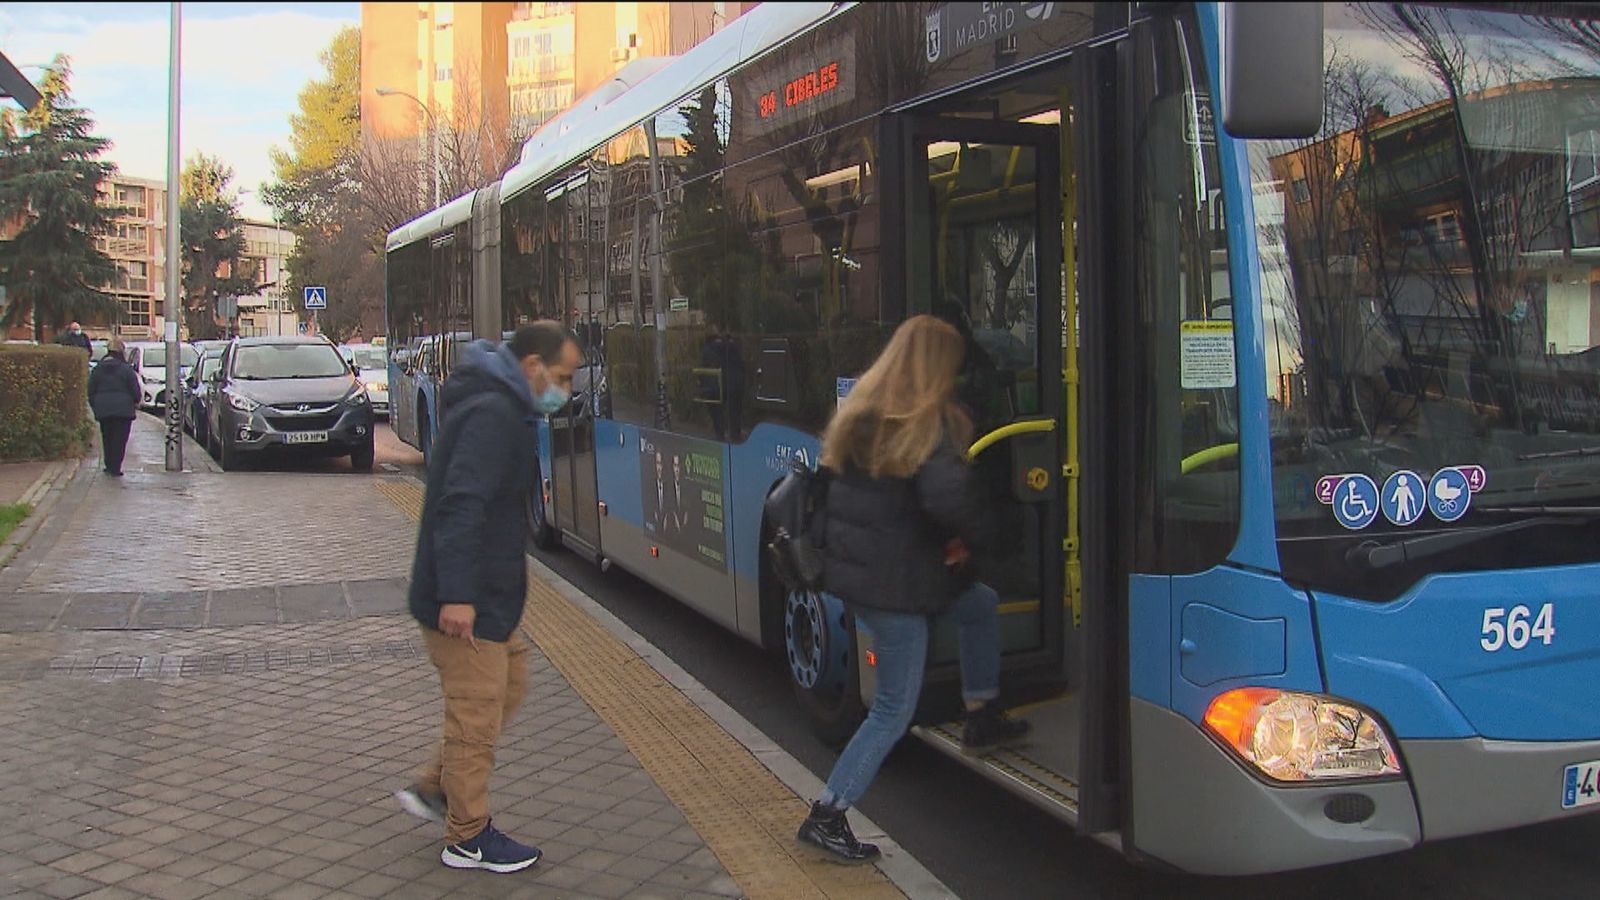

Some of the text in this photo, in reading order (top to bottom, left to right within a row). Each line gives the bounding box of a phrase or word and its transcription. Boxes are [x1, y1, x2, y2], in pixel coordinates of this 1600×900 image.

[956, 8, 1015, 48] MADRID
[760, 90, 777, 118] 84
[776, 444, 791, 459] EMT
[1321, 480, 1331, 496] 2
[1470, 469, 1480, 485] 4
[1480, 602, 1556, 652] 564
